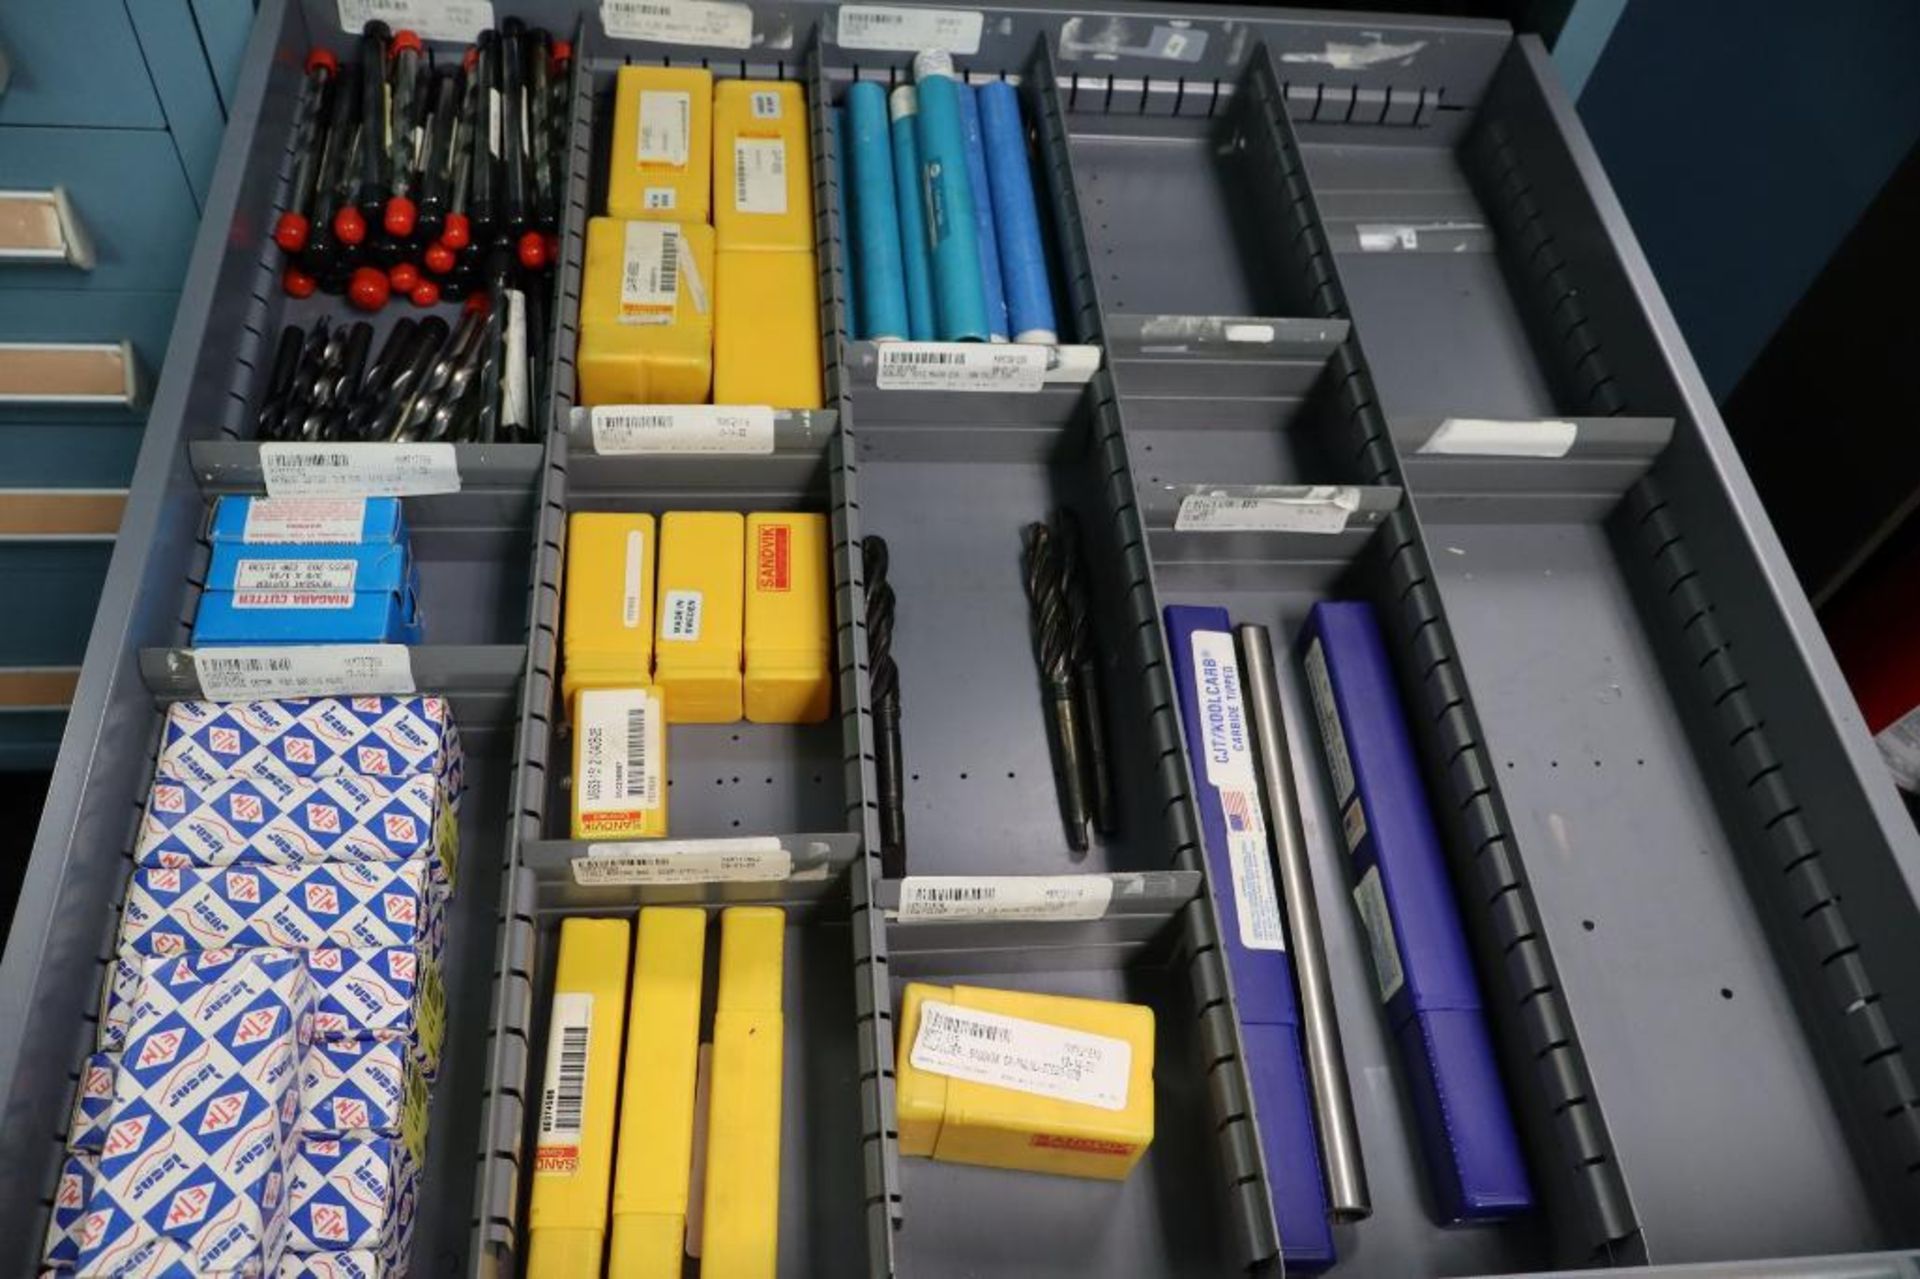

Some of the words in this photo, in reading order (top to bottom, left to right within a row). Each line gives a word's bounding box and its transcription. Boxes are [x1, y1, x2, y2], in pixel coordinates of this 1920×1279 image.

[759, 526, 775, 588] SANDVIK
[239, 594, 288, 604] CUTTER
[293, 594, 350, 604] NIAGARA
[673, 610, 682, 634] MADE
[685, 600, 696, 634] SWEDEN
[1222, 665, 1238, 701] TIPPED
[1227, 705, 1245, 753] CARBIDE
